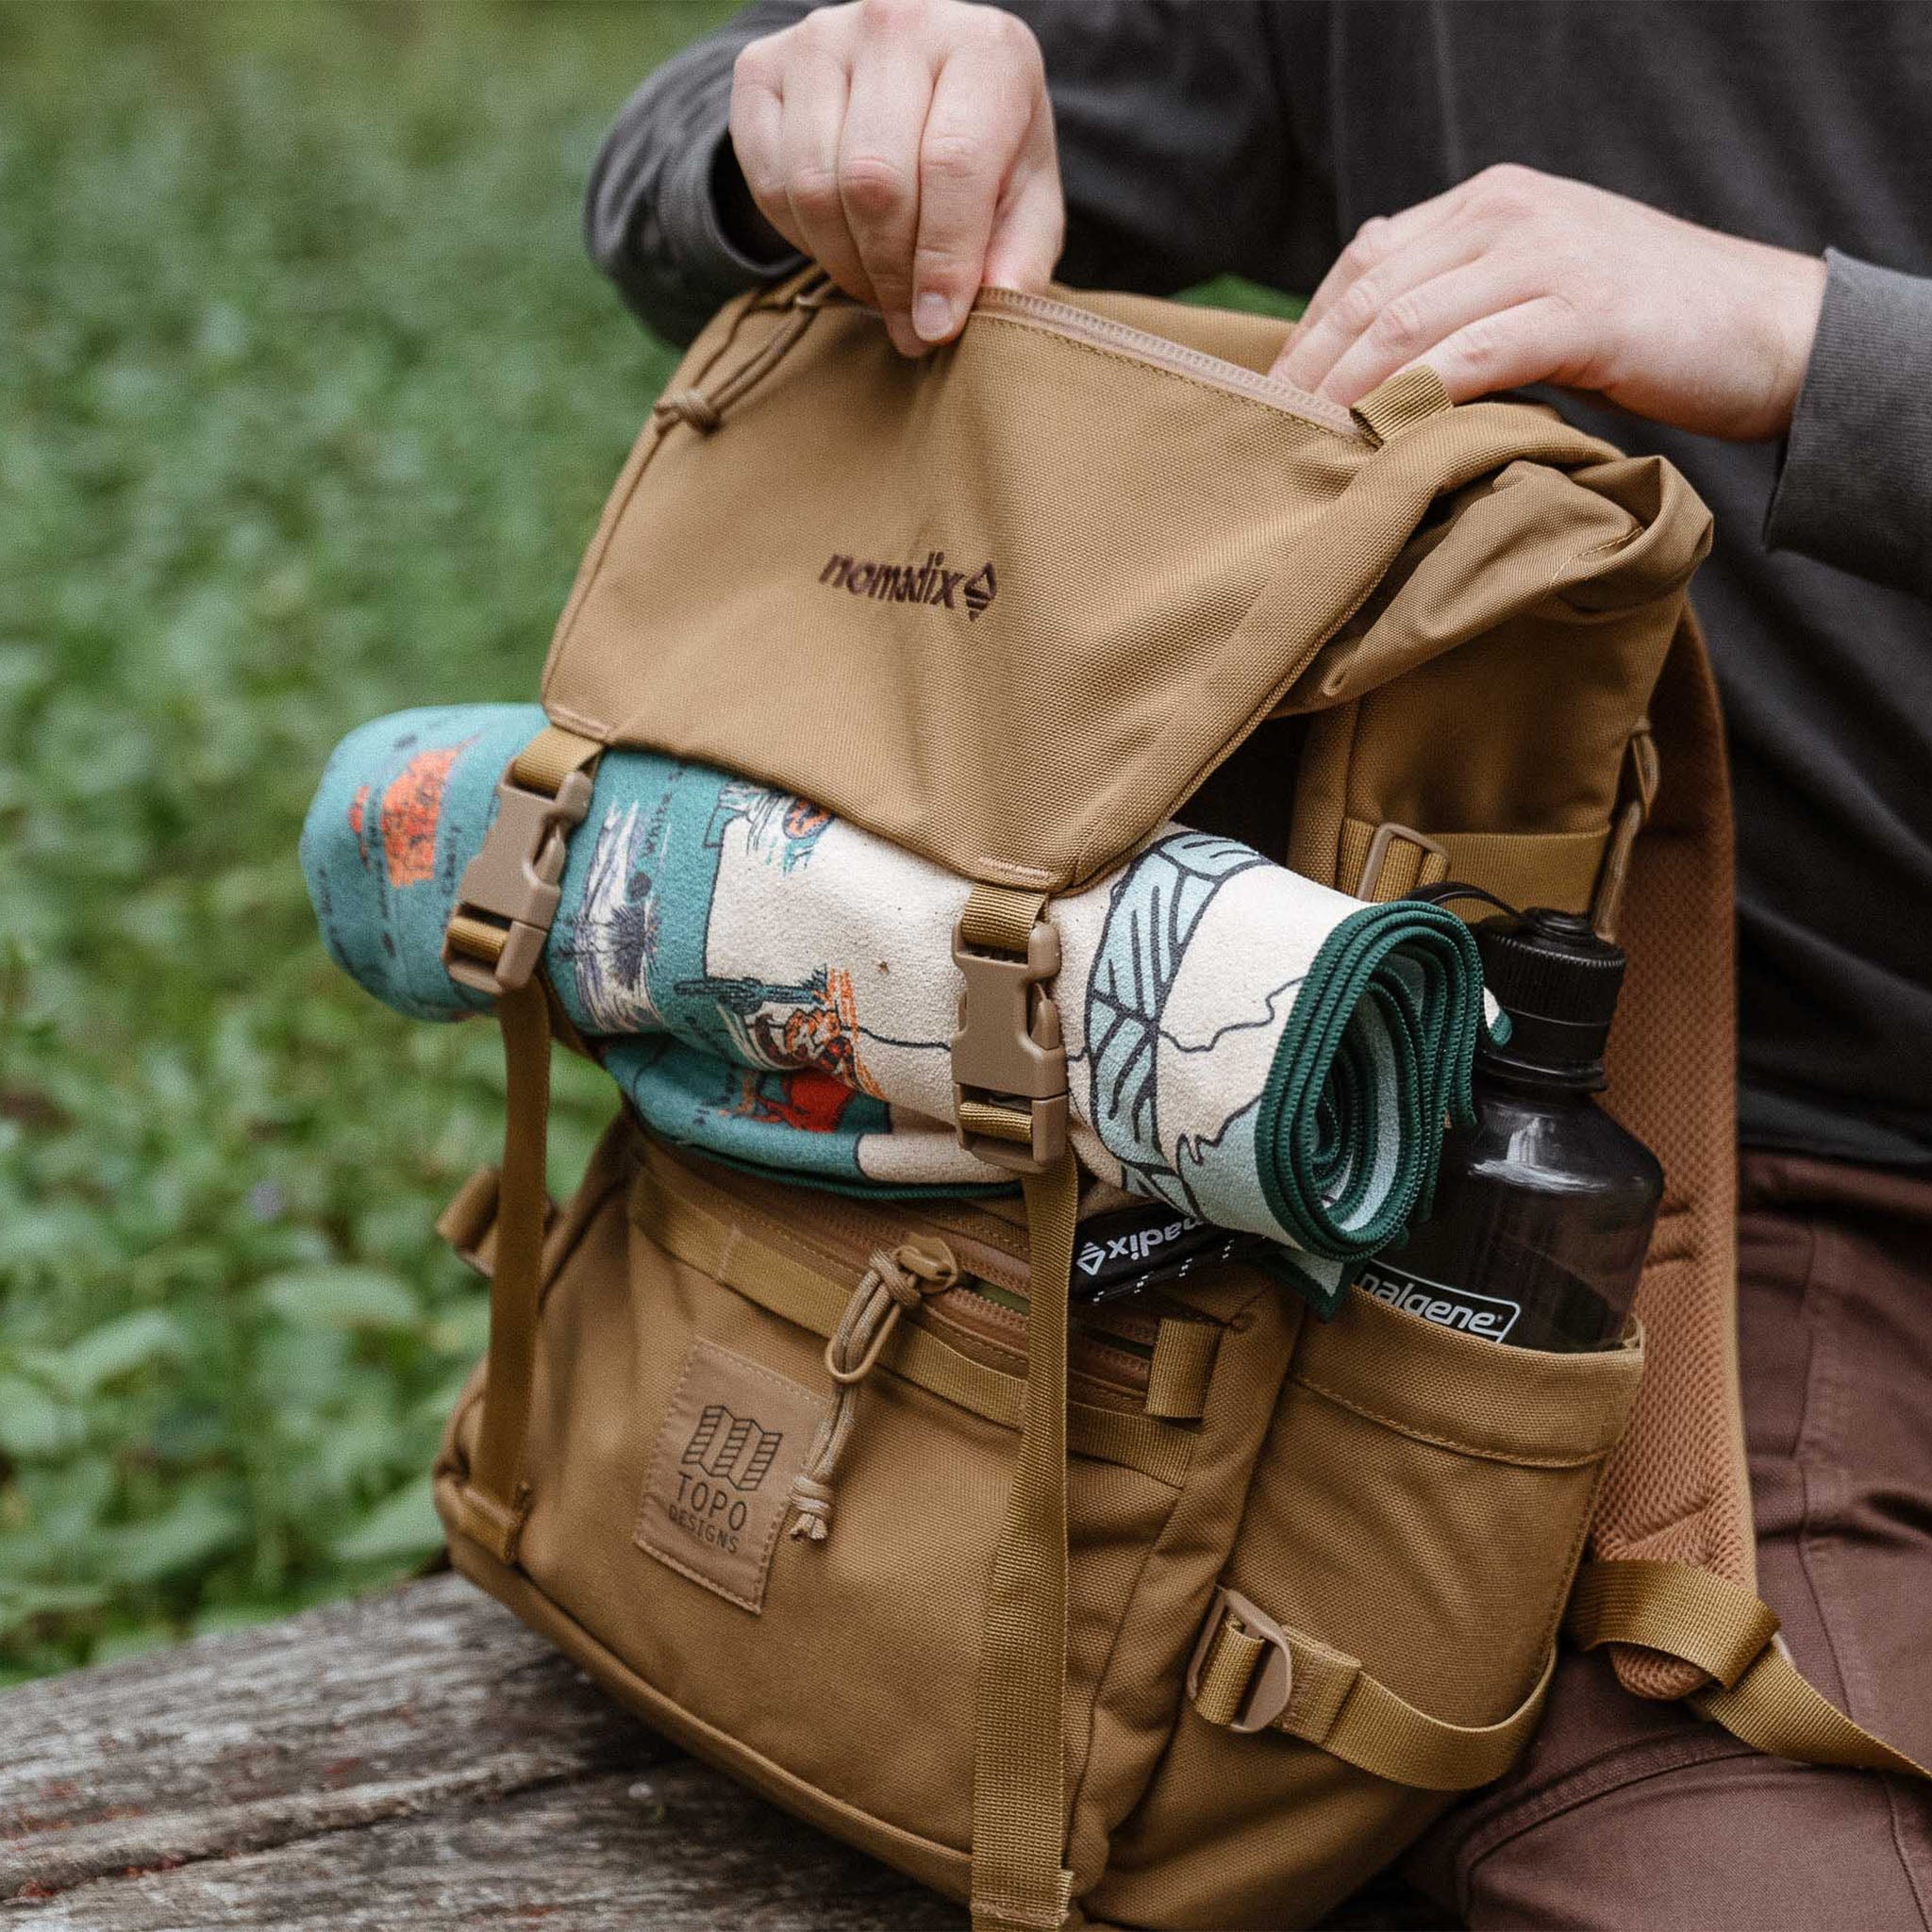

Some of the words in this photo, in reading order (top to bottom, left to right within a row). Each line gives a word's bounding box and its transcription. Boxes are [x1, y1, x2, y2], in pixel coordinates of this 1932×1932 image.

[819, 551, 965, 608] nomadix
[1360, 1274, 1504, 1336] nalgene
[668, 1504, 739, 1554] DESIGNS
[677, 1471, 747, 1531] TOPO
